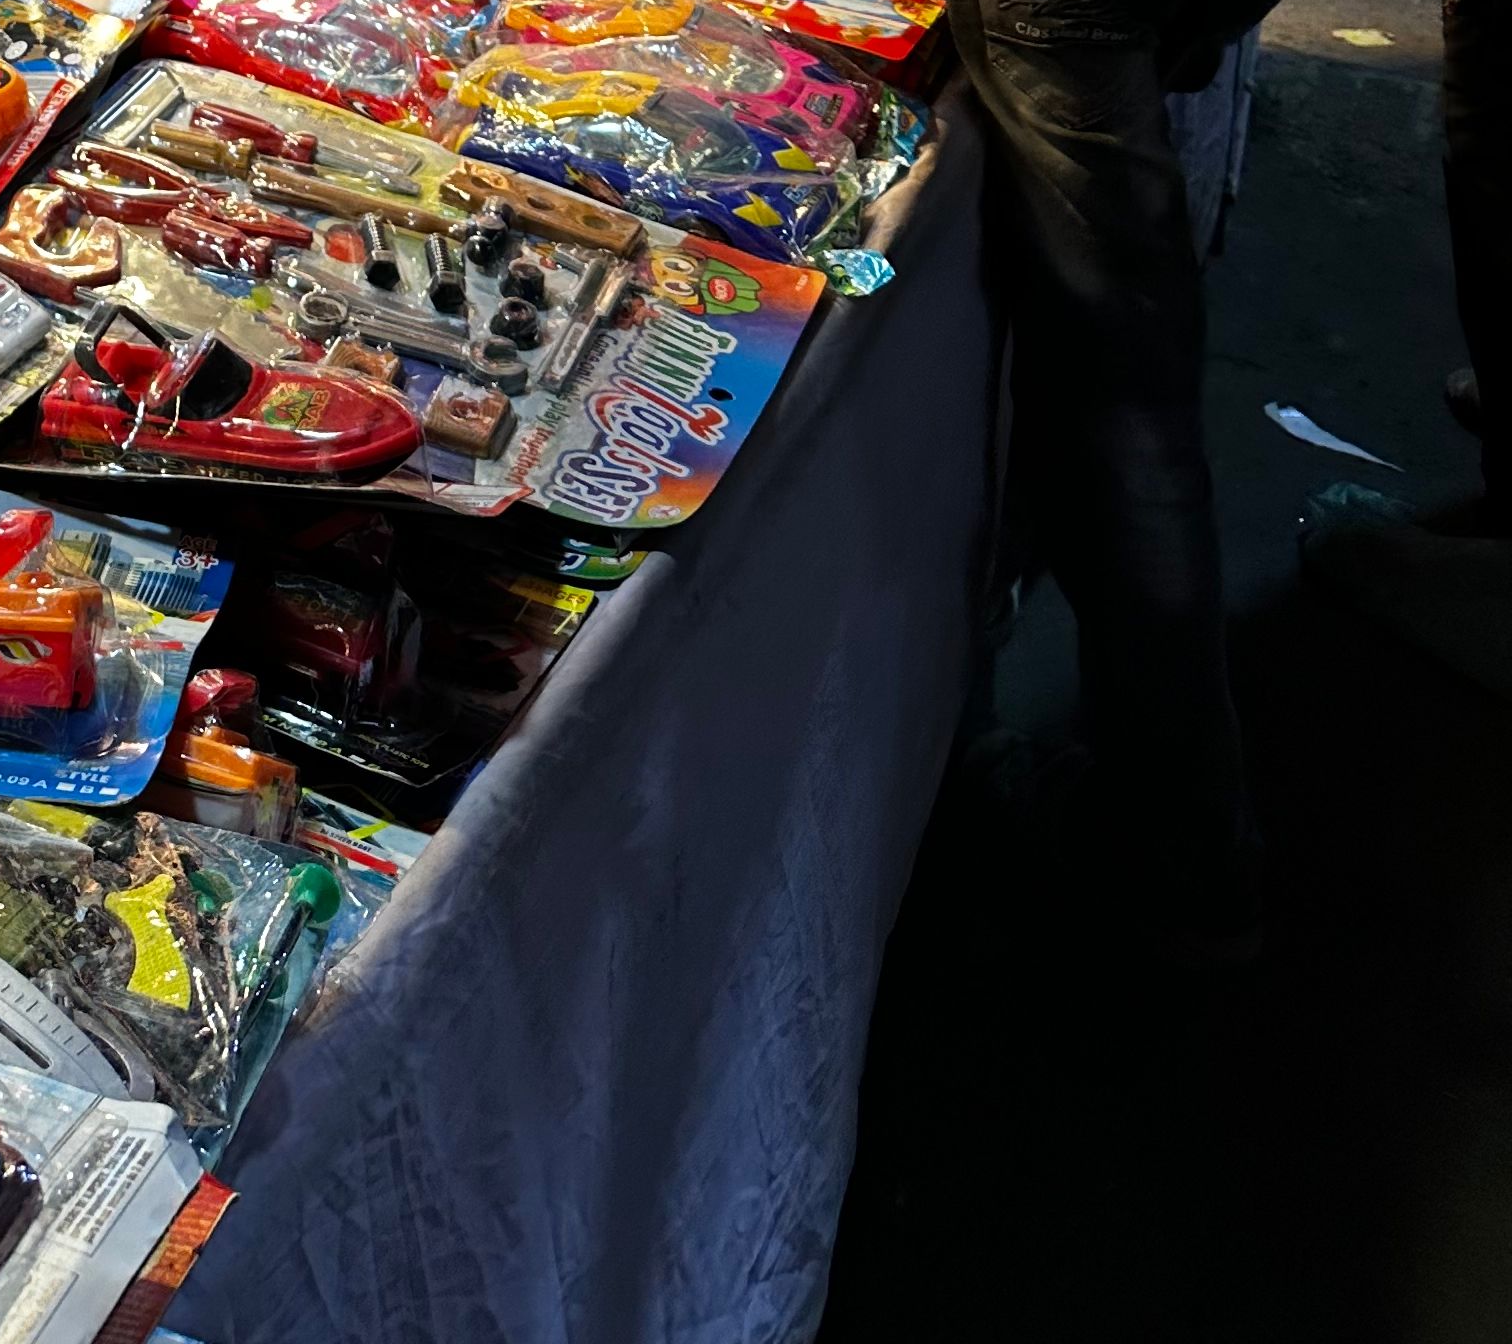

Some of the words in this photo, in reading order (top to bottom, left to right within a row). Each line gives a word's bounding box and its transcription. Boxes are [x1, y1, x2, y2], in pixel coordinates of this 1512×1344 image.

[603, 376, 728, 479] Tools
[545, 450, 657, 522] SET
[175, 548, 219, 570] 3+
[31, 778, 48, 790] A
[84, 782, 94, 794] B
[55, 768, 112, 784] STYLE
